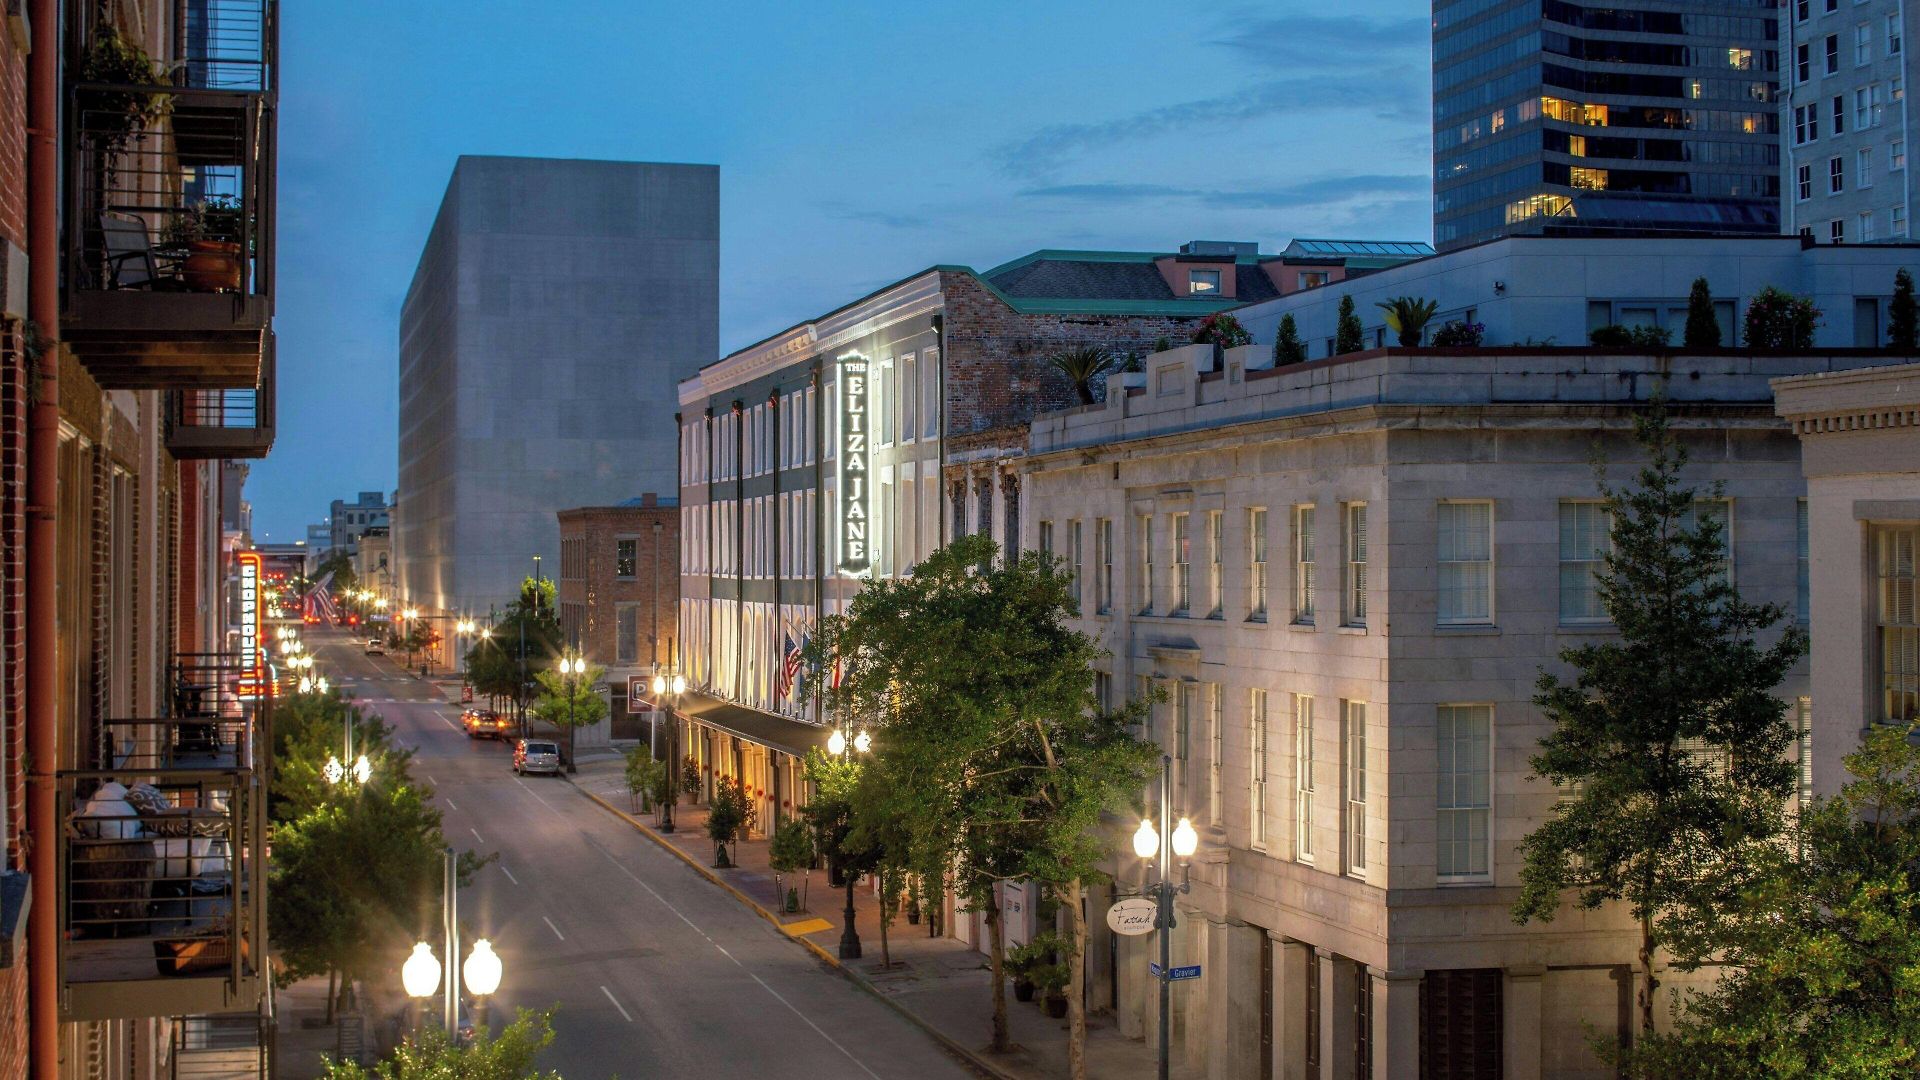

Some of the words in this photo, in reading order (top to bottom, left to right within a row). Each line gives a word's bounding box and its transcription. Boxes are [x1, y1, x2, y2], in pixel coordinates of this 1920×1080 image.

[845, 363, 866, 372] THE
[847, 377, 865, 470] ELIZA
[847, 478, 865, 560] JANE
[1174, 969, 1196, 978] Gravier
